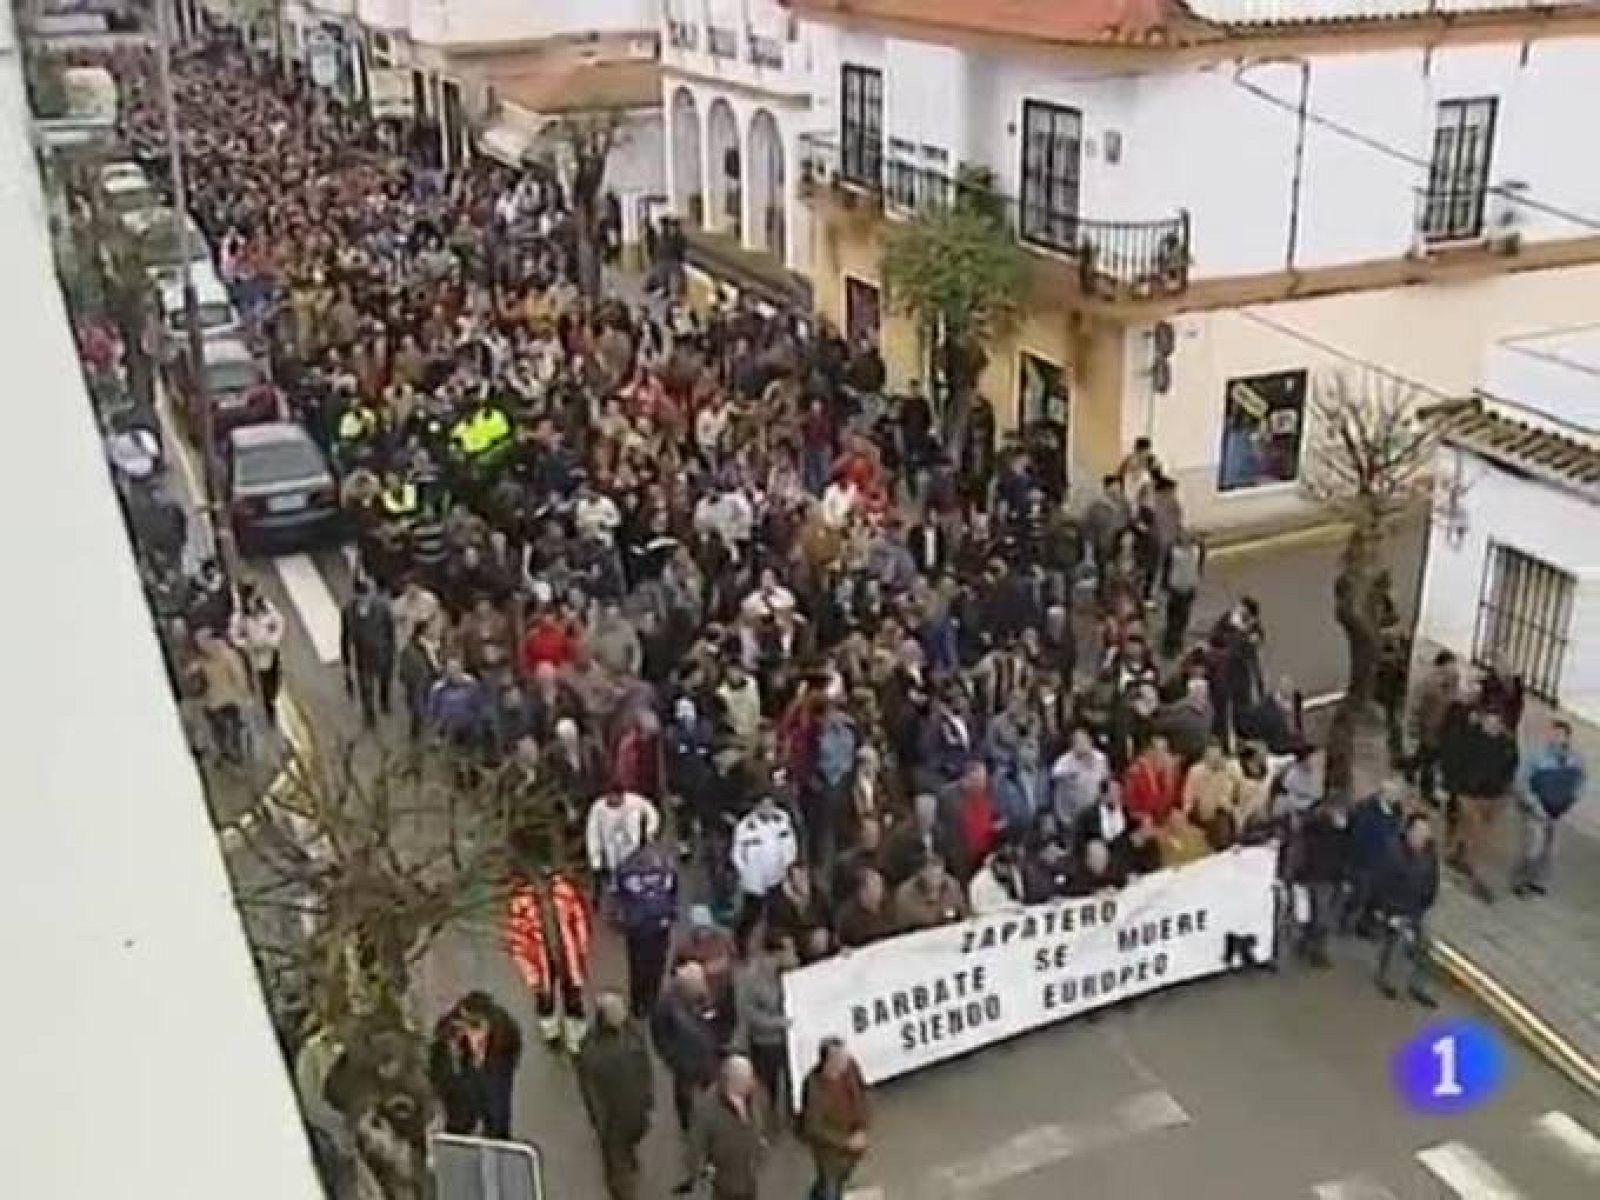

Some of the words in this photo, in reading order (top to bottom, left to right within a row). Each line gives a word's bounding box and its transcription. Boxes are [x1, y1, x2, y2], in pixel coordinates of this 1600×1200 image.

[851, 966, 987, 1033] BARBATE
[1035, 945, 1068, 971] SE
[1118, 909, 1208, 952] MUERE
[961, 902, 1117, 953] ZAPATERO
[901, 995, 1001, 1049] SIENDO
[1043, 953, 1168, 1008] EUROPEO
